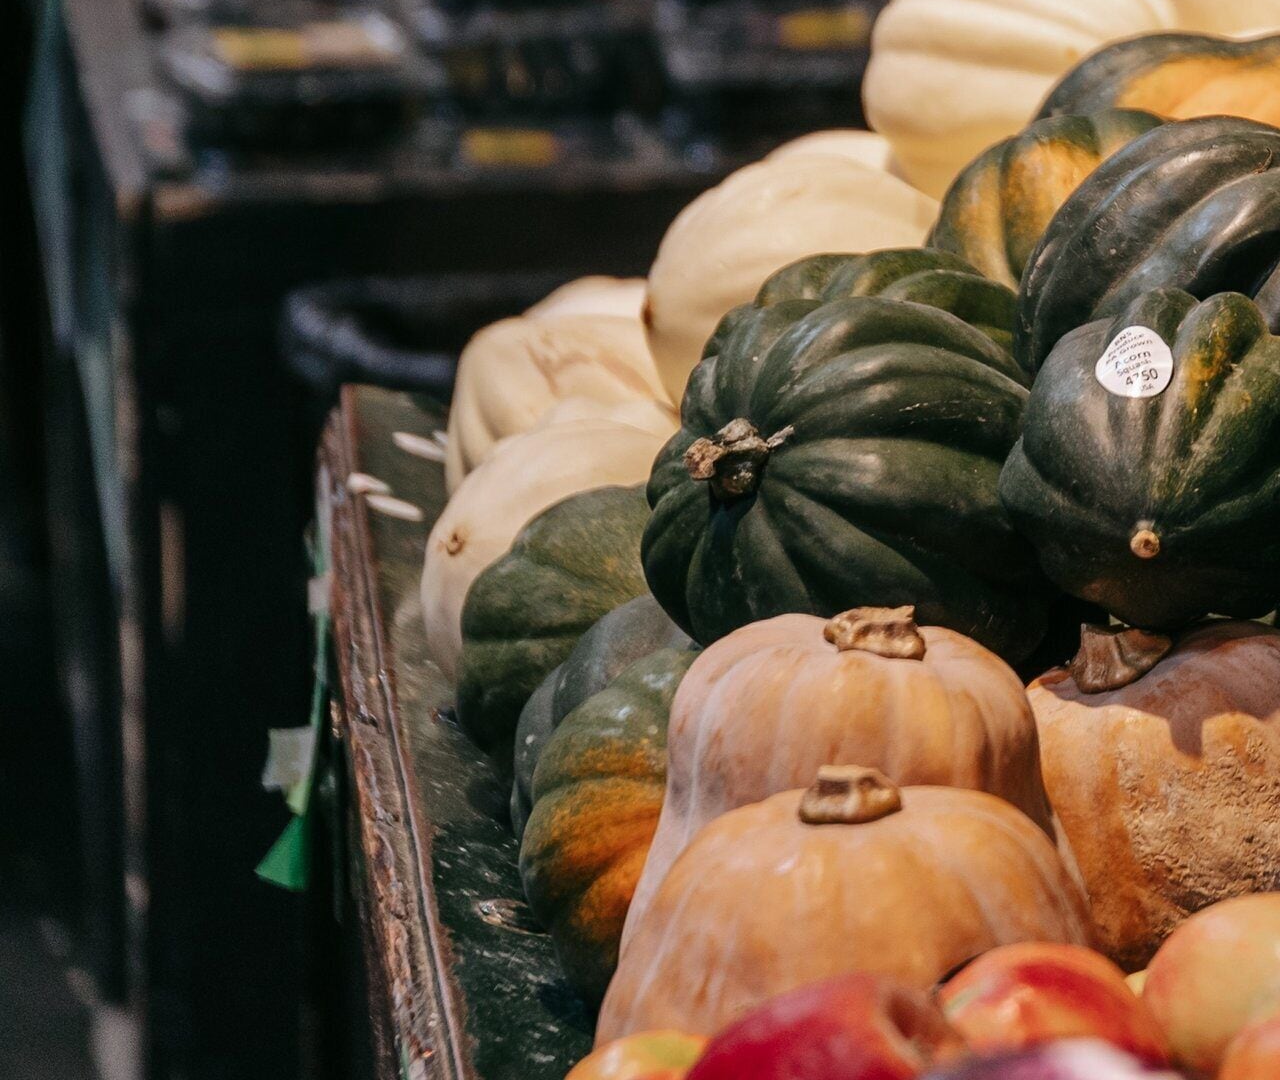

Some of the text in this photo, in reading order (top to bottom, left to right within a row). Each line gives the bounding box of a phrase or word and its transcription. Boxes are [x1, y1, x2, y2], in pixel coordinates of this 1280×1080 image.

[1115, 351, 1151, 369] Acorn
[1117, 359, 1152, 377] Squash
[1126, 368, 1158, 385] 4750
